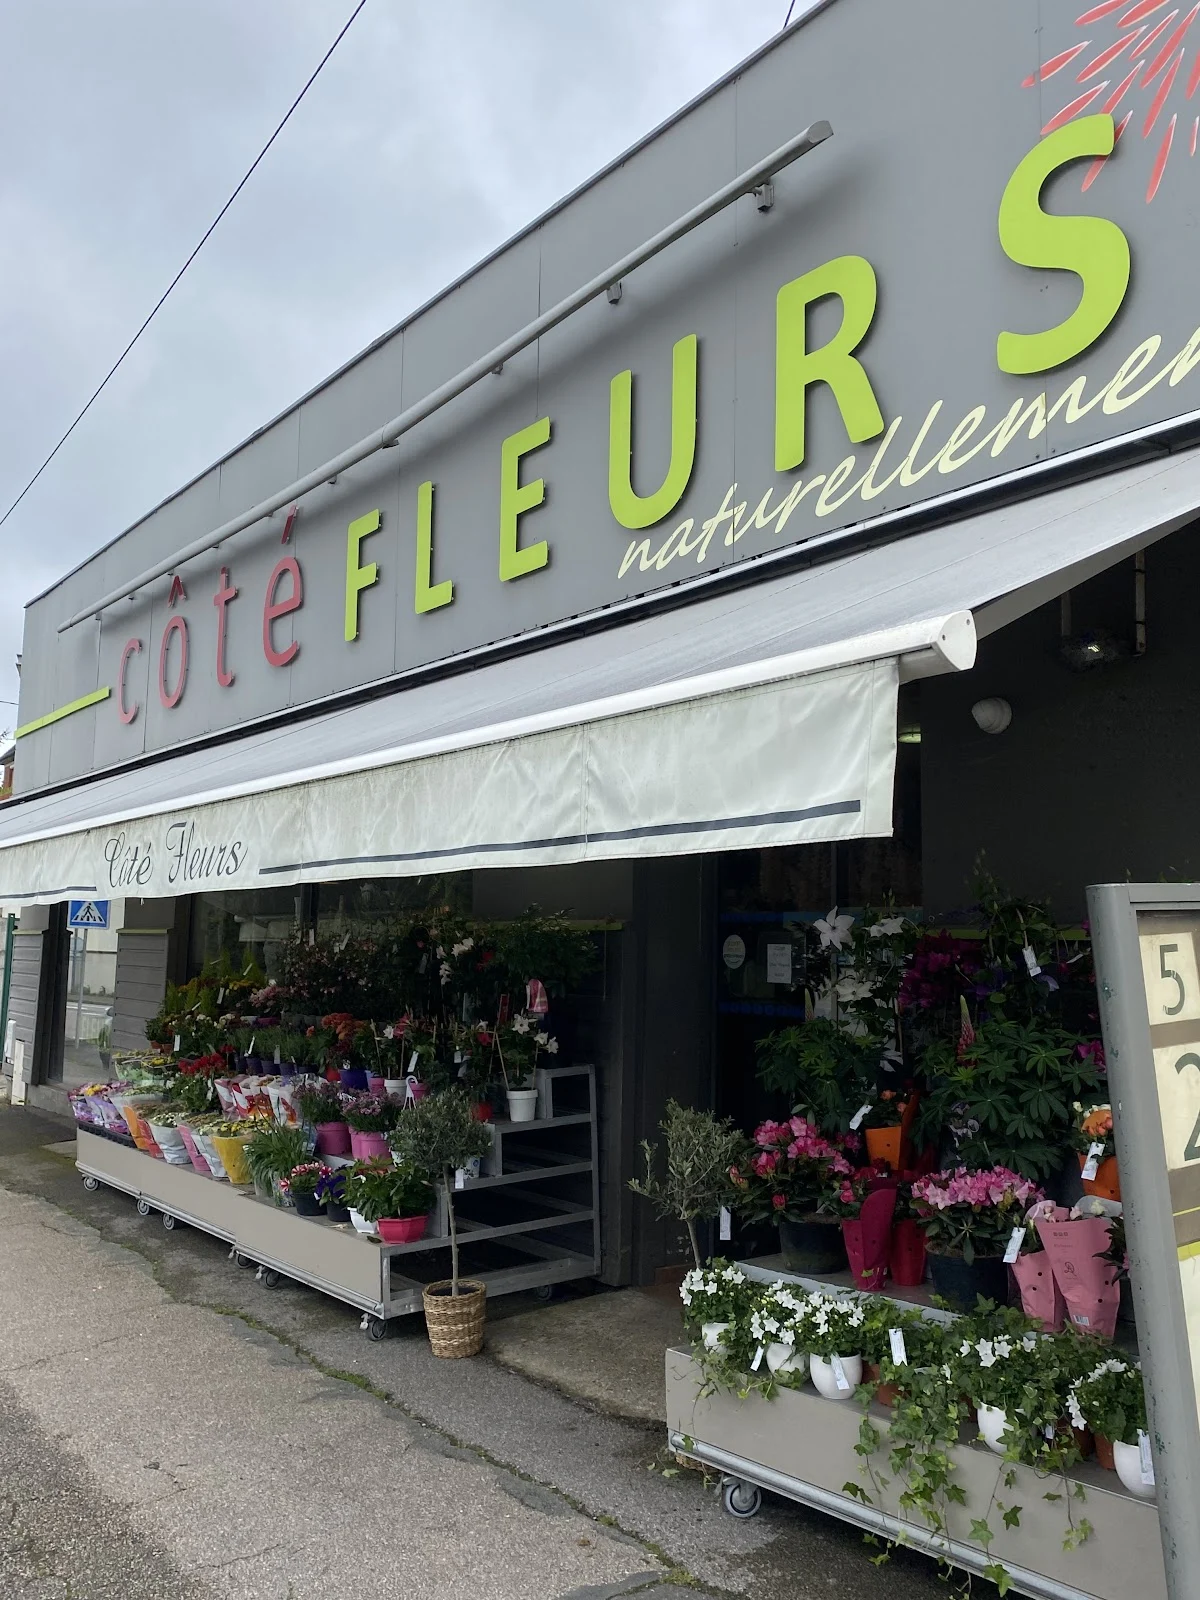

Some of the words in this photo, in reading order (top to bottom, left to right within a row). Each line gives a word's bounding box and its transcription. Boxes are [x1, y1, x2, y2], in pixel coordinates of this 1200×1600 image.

[118, 505, 303, 724] côté
[343, 113, 1131, 641] FLEURS
[165, 821, 249, 884] Fleurs
[1160, 944, 1186, 1016] 5
